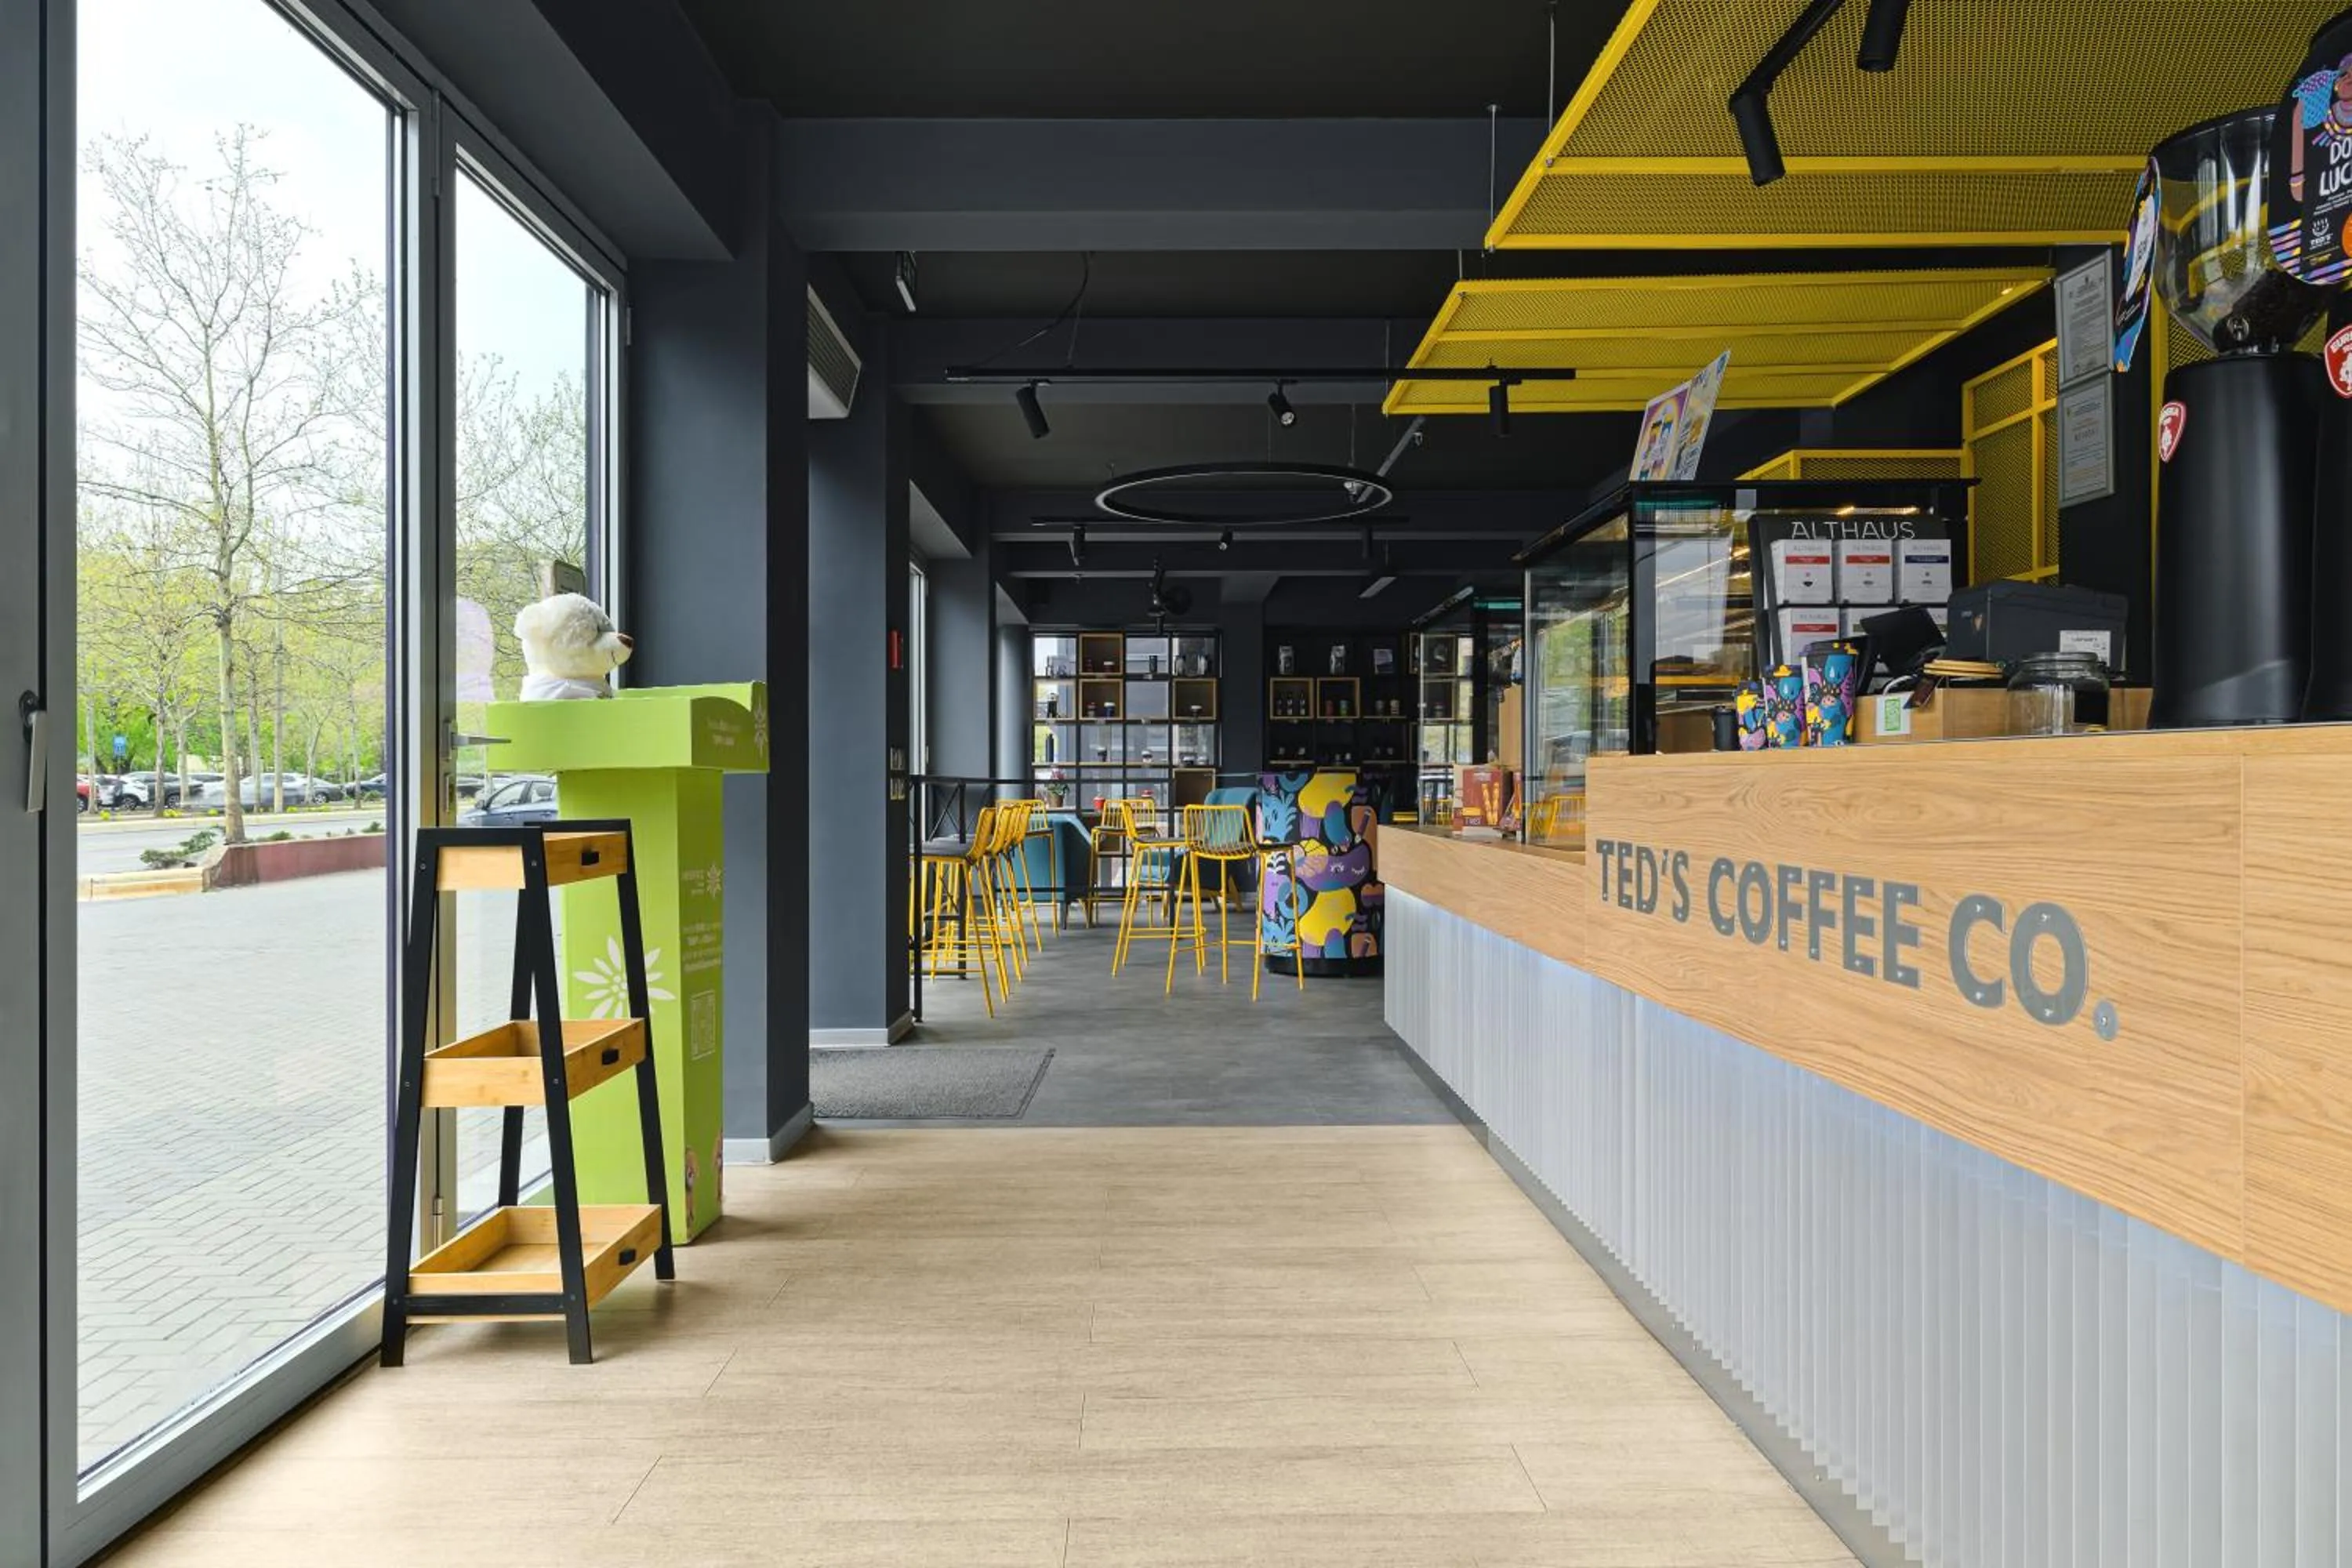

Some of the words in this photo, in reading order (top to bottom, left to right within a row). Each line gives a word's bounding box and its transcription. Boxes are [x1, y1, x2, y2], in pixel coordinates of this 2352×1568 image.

[1791, 521, 1916, 540] ALTHAUS
[1596, 840, 1690, 923] TED'S
[1708, 857, 1921, 989] COFFEE
[1948, 893, 2118, 1042] CO.
